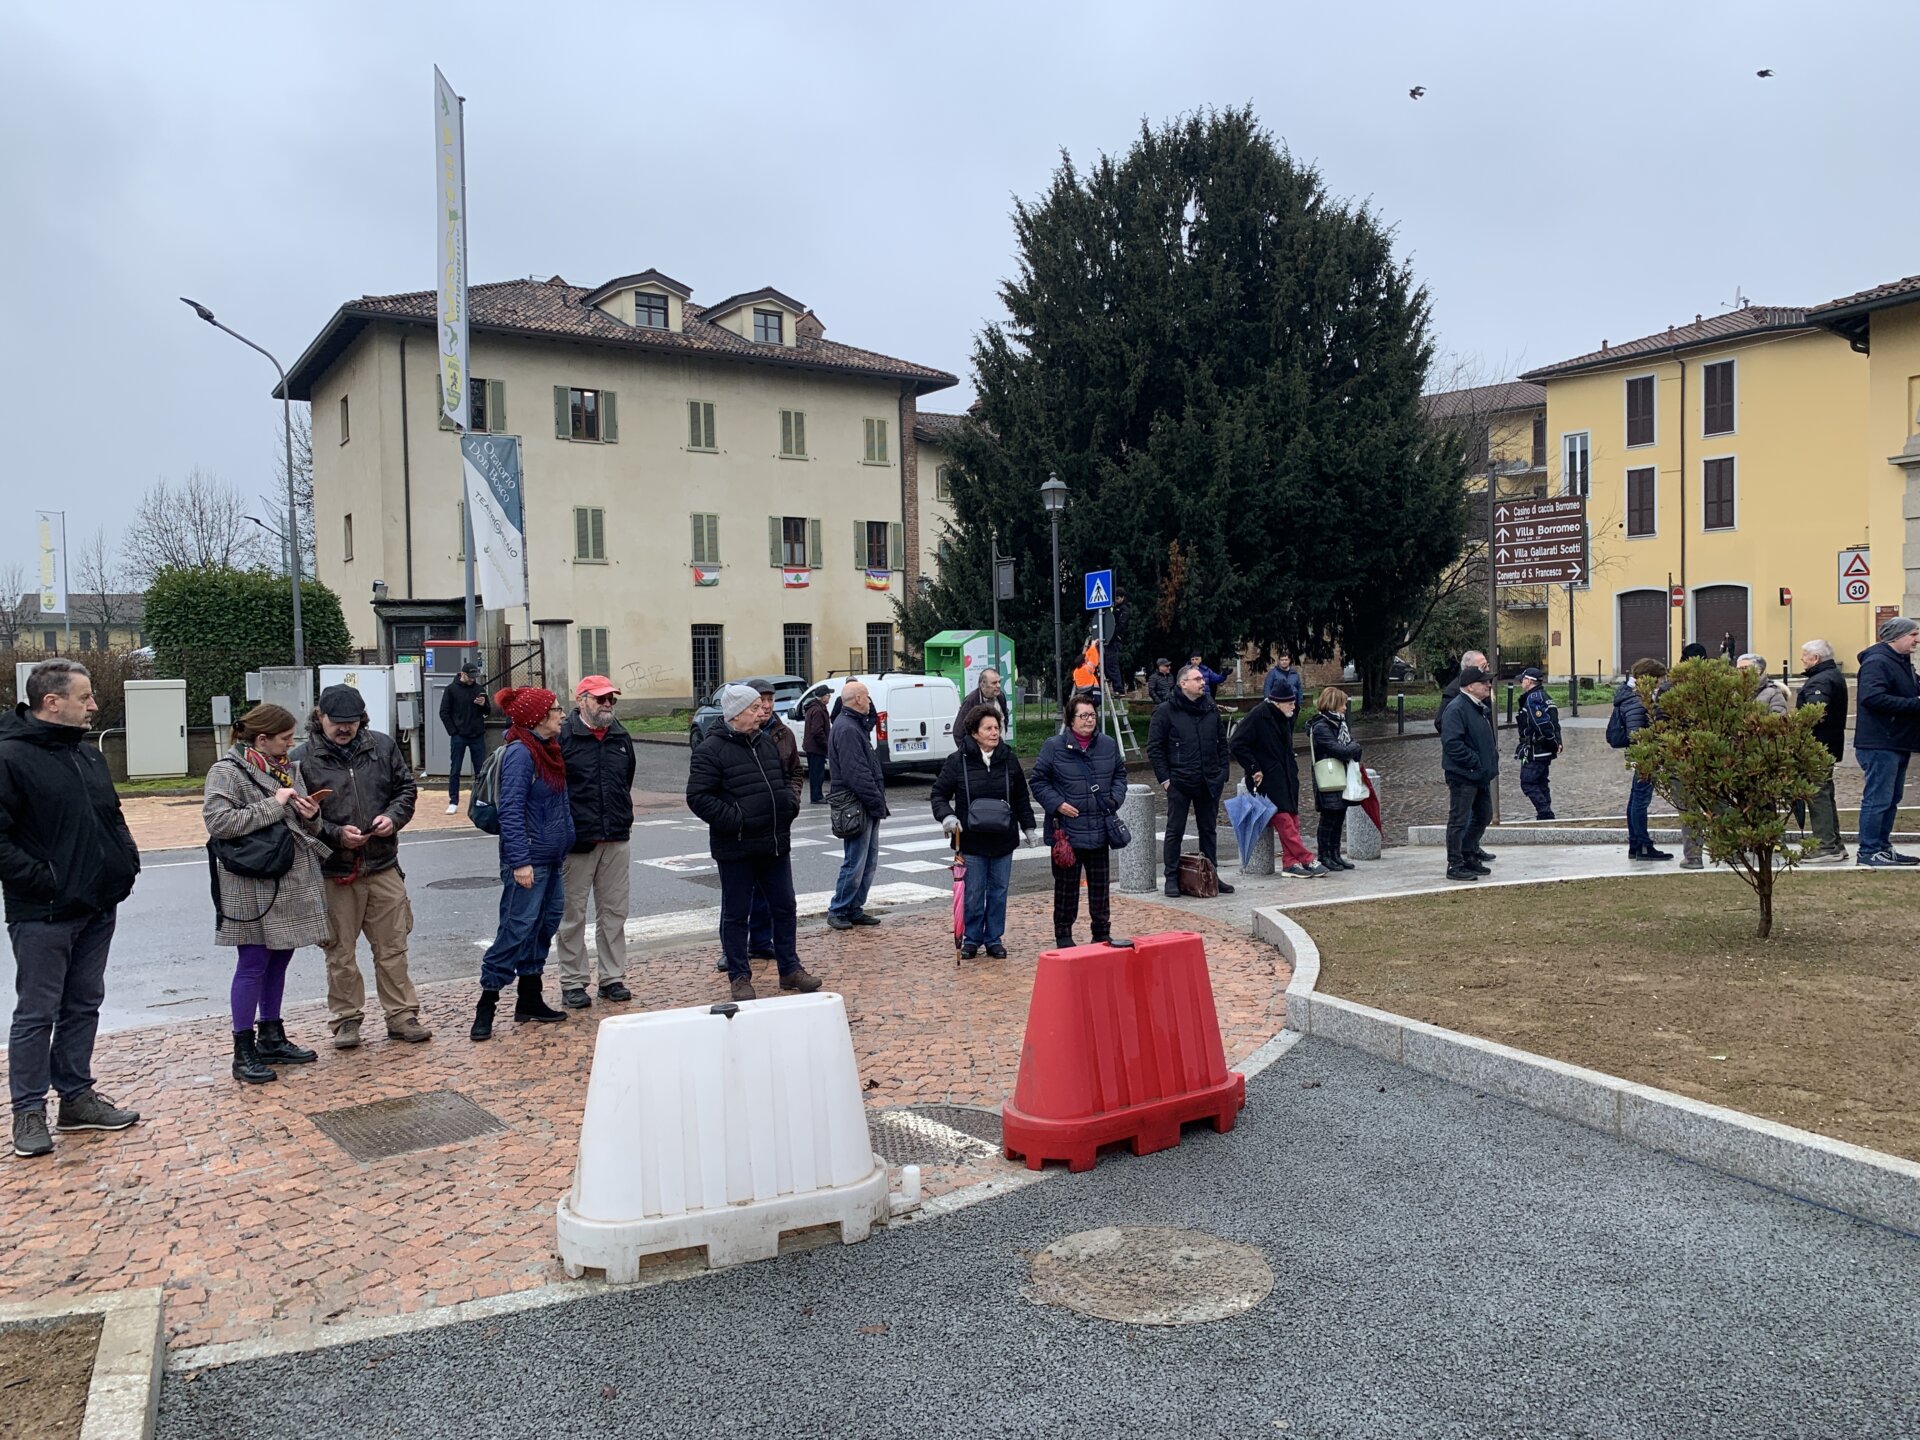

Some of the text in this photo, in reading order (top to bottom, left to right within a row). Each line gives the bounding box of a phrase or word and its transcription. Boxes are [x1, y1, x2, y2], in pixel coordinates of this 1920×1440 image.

[468, 441, 490, 470] Don
[489, 467, 510, 503] Bosco
[484, 441, 516, 489] Oratorio
[1514, 502, 1580, 516] Casino di caccia Borromeo
[1515, 524, 1580, 537] Villa Borromeo
[1514, 543, 1580, 558] Villa Gallarati Scotti
[1497, 567, 1562, 580] Convento di S. Francesco
[1851, 585, 1865, 595] 30
